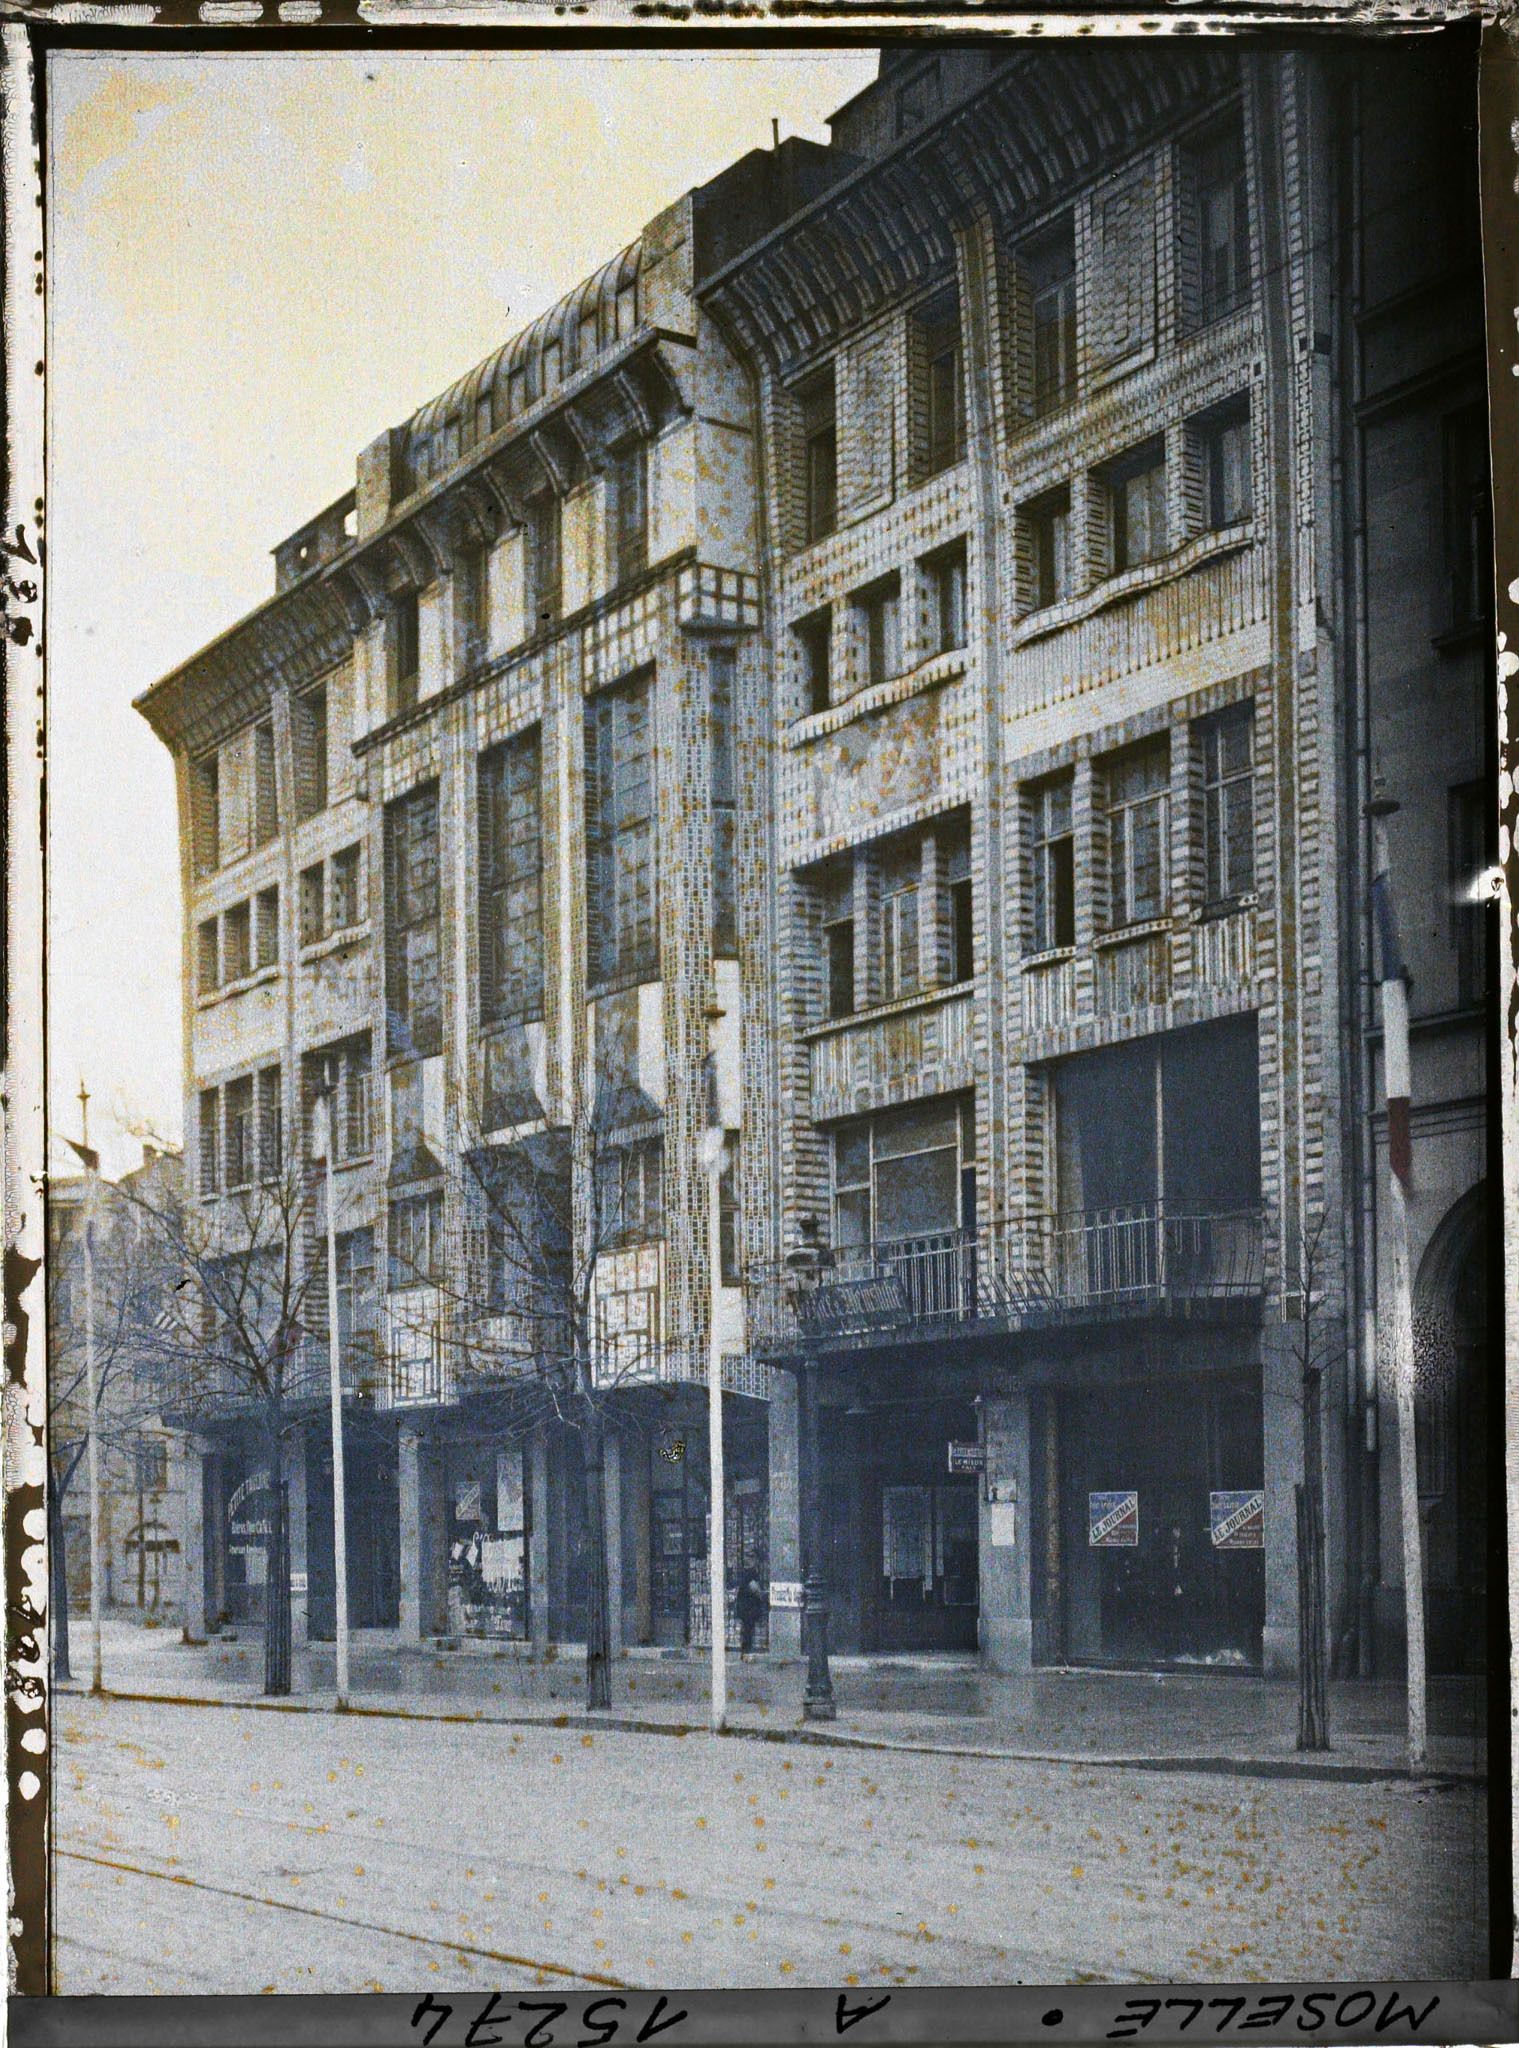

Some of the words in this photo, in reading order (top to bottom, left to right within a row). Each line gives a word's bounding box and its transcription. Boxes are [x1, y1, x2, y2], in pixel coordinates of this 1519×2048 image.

[1091, 1525, 1103, 1540] LE
[1101, 1497, 1136, 1532] JOURNAL
[1212, 1527, 1225, 1542] LE
[1224, 1497, 1263, 1534] JOURNAL
